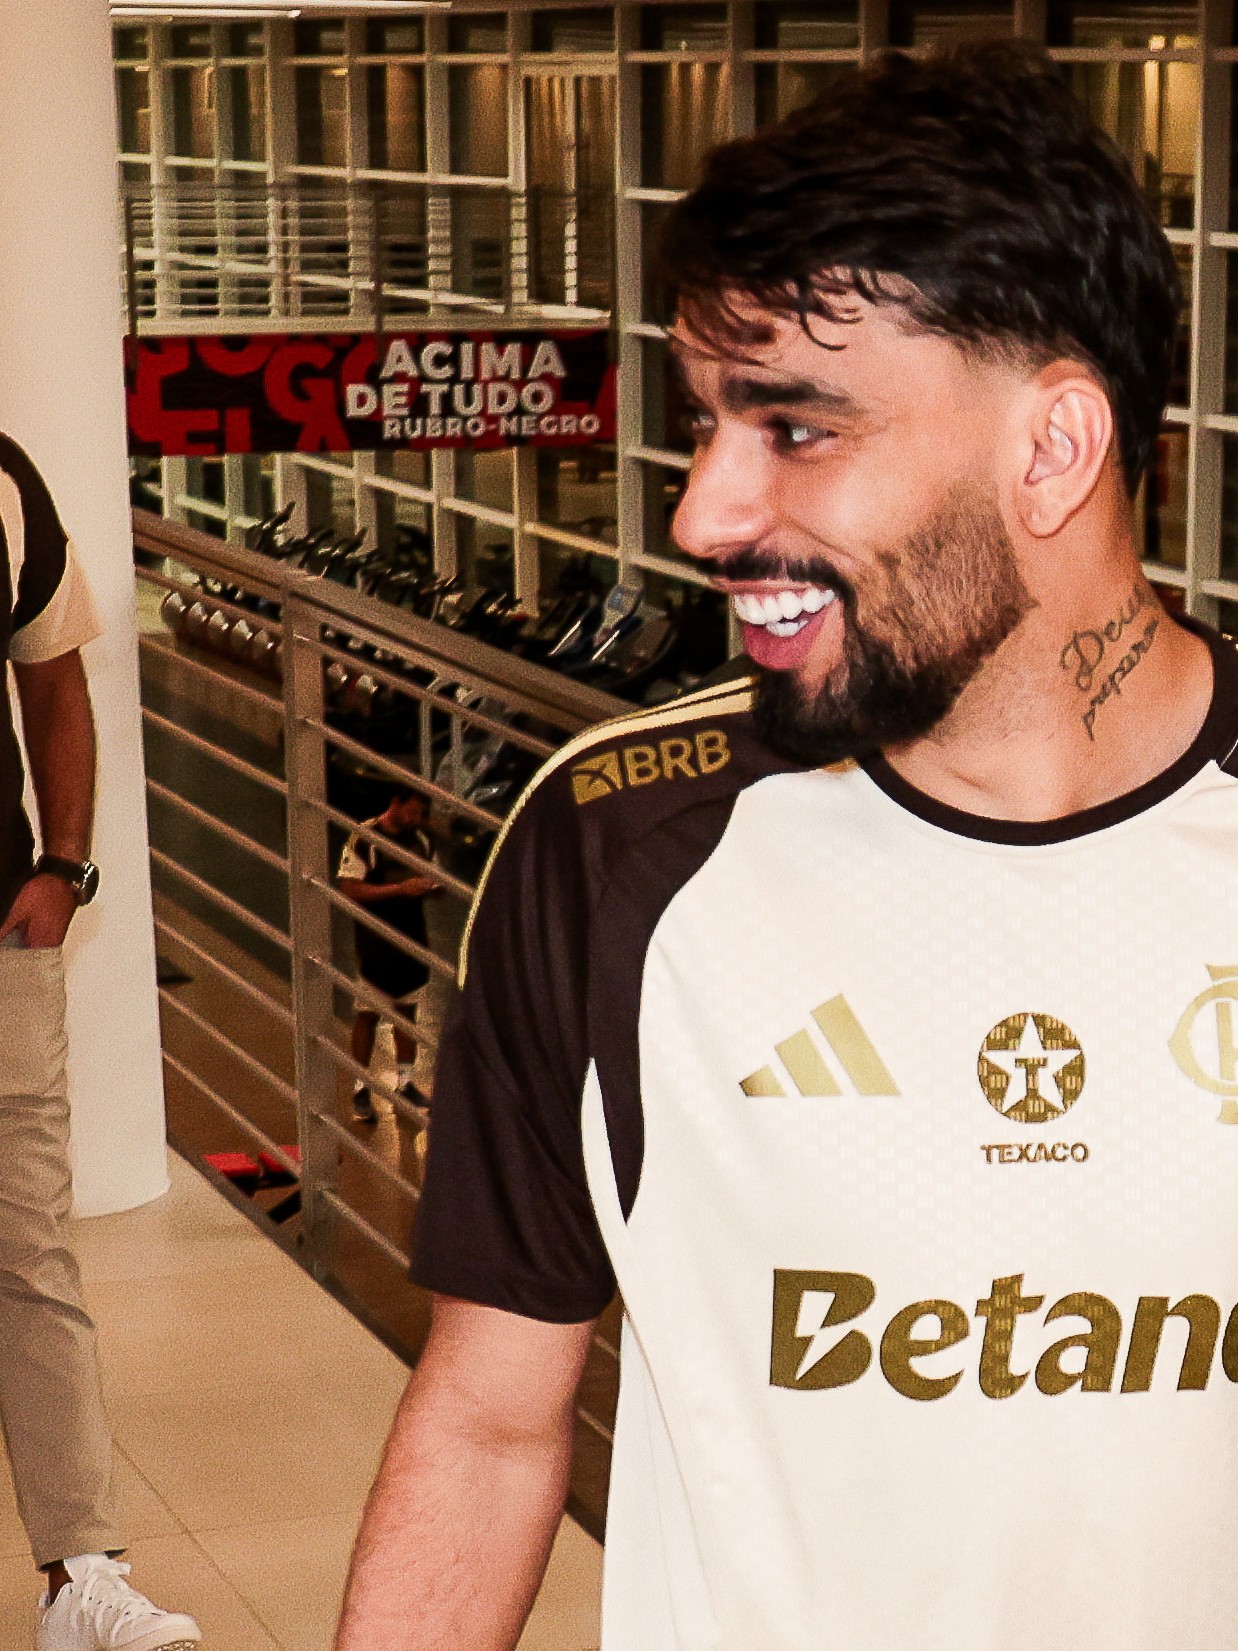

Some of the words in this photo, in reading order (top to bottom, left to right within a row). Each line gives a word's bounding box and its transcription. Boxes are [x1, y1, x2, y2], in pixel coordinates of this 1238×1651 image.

[378, 339, 567, 381] ACIMA
[345, 383, 411, 417] DE
[420, 381, 556, 416] TUDO
[382, 413, 600, 440] RUBRO-NEGRO
[624, 729, 732, 787] BRB
[979, 1141, 1090, 1165] TEXACO
